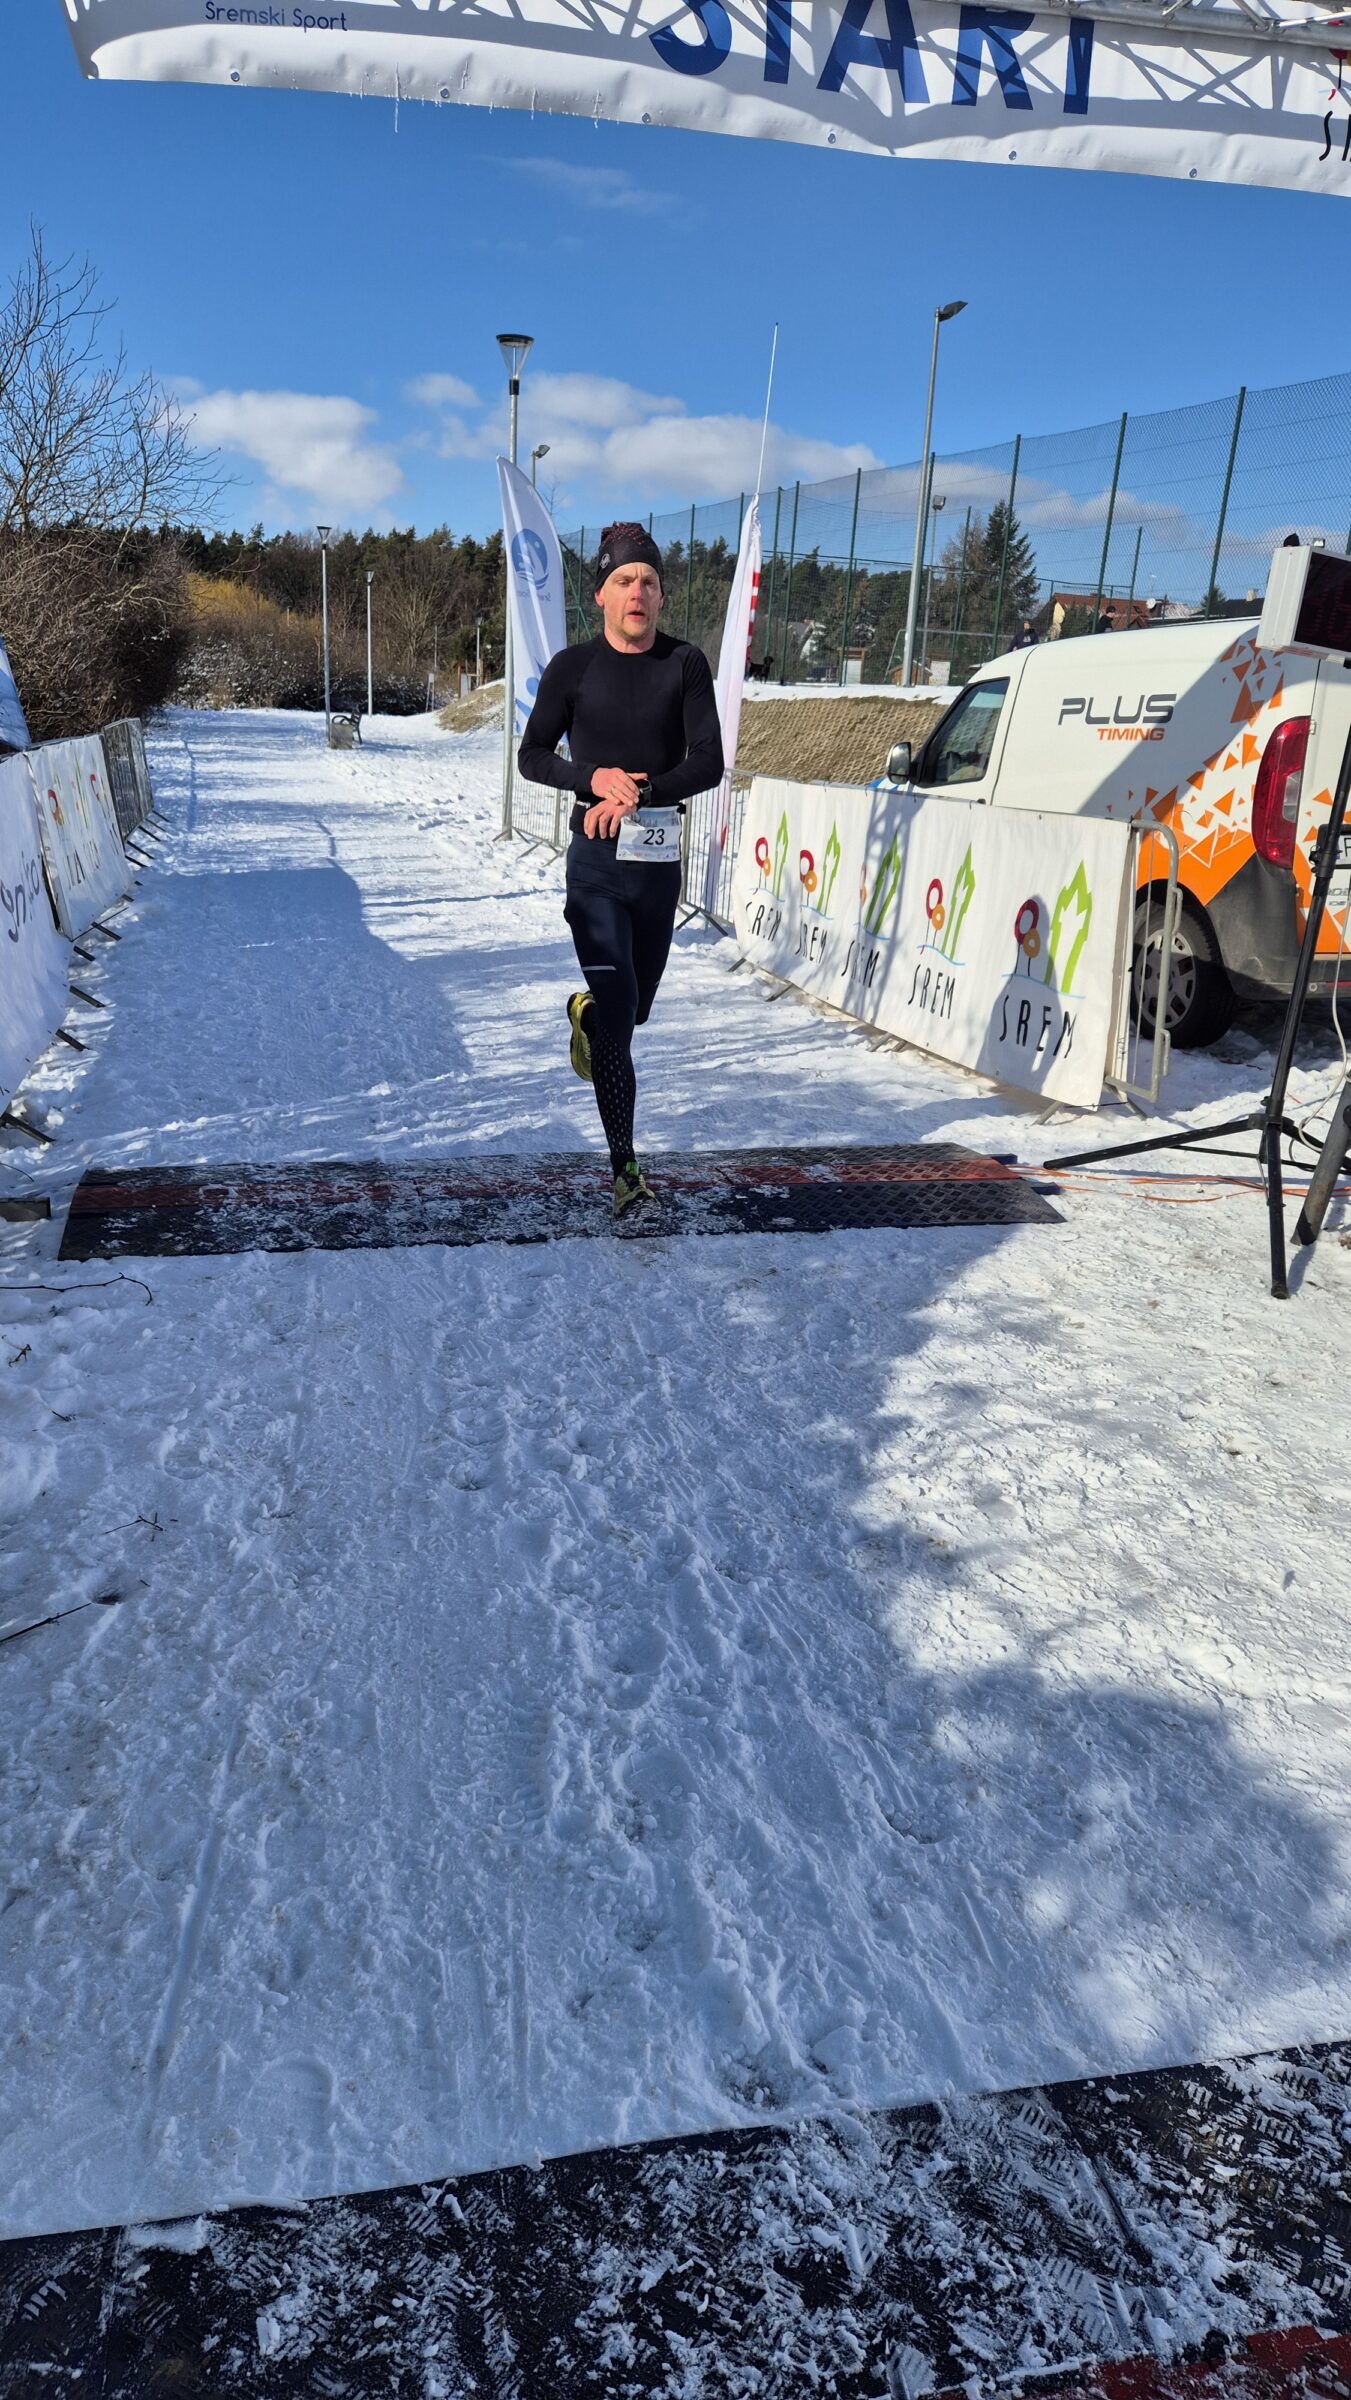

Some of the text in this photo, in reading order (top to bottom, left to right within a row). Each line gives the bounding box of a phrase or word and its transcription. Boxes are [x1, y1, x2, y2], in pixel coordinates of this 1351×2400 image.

[292, 8, 349, 33] Sport
[1057, 693, 1177, 726] PLUS
[1097, 727, 1166, 742] TIMING
[643, 828, 666, 846] 23
